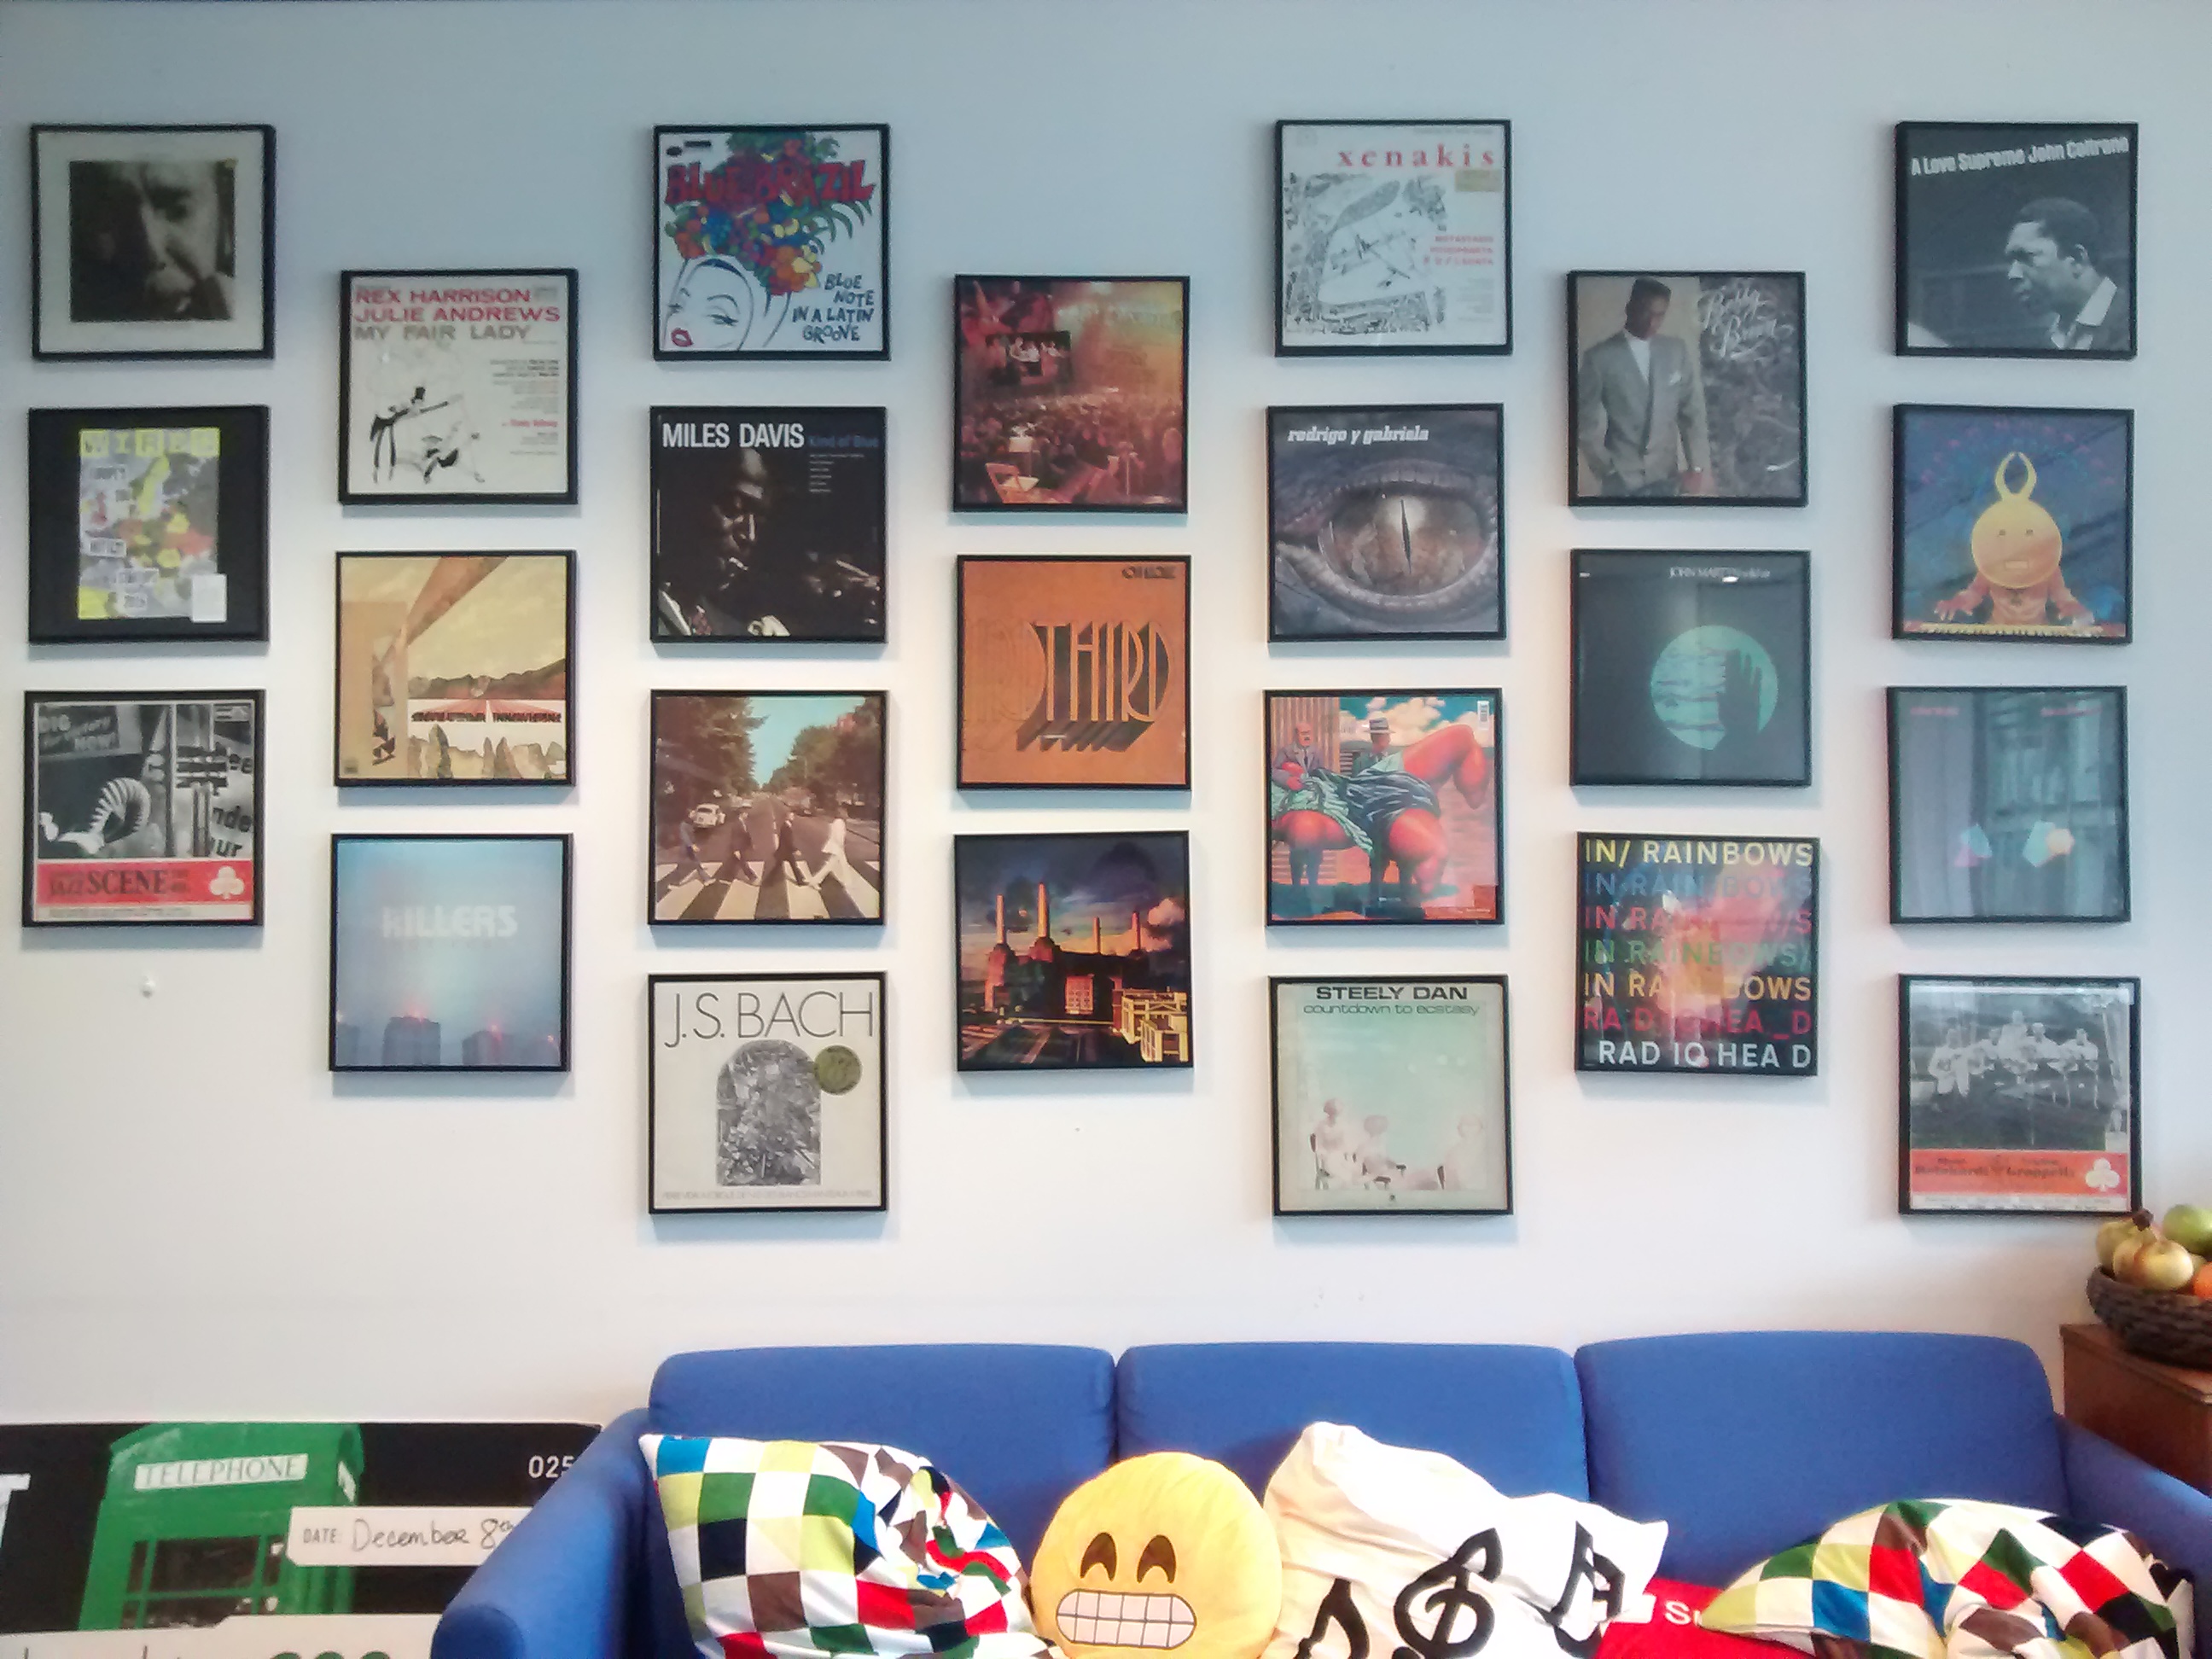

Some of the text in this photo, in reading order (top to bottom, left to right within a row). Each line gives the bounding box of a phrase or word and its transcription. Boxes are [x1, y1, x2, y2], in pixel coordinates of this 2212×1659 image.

[1338, 143, 1494, 167] xenakis
[1912, 158, 1921, 176] A
[1923, 156, 1957, 174] Love
[2028, 143, 2065, 164] John
[666, 160, 875, 207] BLUE BRAZIL
[824, 273, 863, 290] BLUE
[354, 288, 531, 303] REX HARRISON
[832, 289, 875, 307] NOTE
[354, 306, 560, 323] JULIE ANDREWS
[792, 306, 875, 323] IN A LATIN
[353, 324, 532, 341] MY FAIR LADY
[802, 325, 861, 345] GROOVE
[662, 422, 731, 448] MILES
[739, 422, 805, 449] DAVIS
[1287, 425, 1429, 446] rodrigo y gabriela
[1031, 620, 1174, 723] THIRD
[1643, 840, 1813, 867] RAINBOWS
[86, 869, 168, 894] SCENE
[382, 905, 518, 938] KILLERS
[1585, 905, 1615, 929] IN
[1585, 940, 1615, 964] IN
[1316, 987, 1468, 1000] STEELY DAN
[1584, 973, 1615, 997] IN
[737, 991, 872, 1039] BACH
[1303, 1004, 1481, 1016] countdown to ecstasy
[140, 1456, 301, 1488] TELEPHONE
